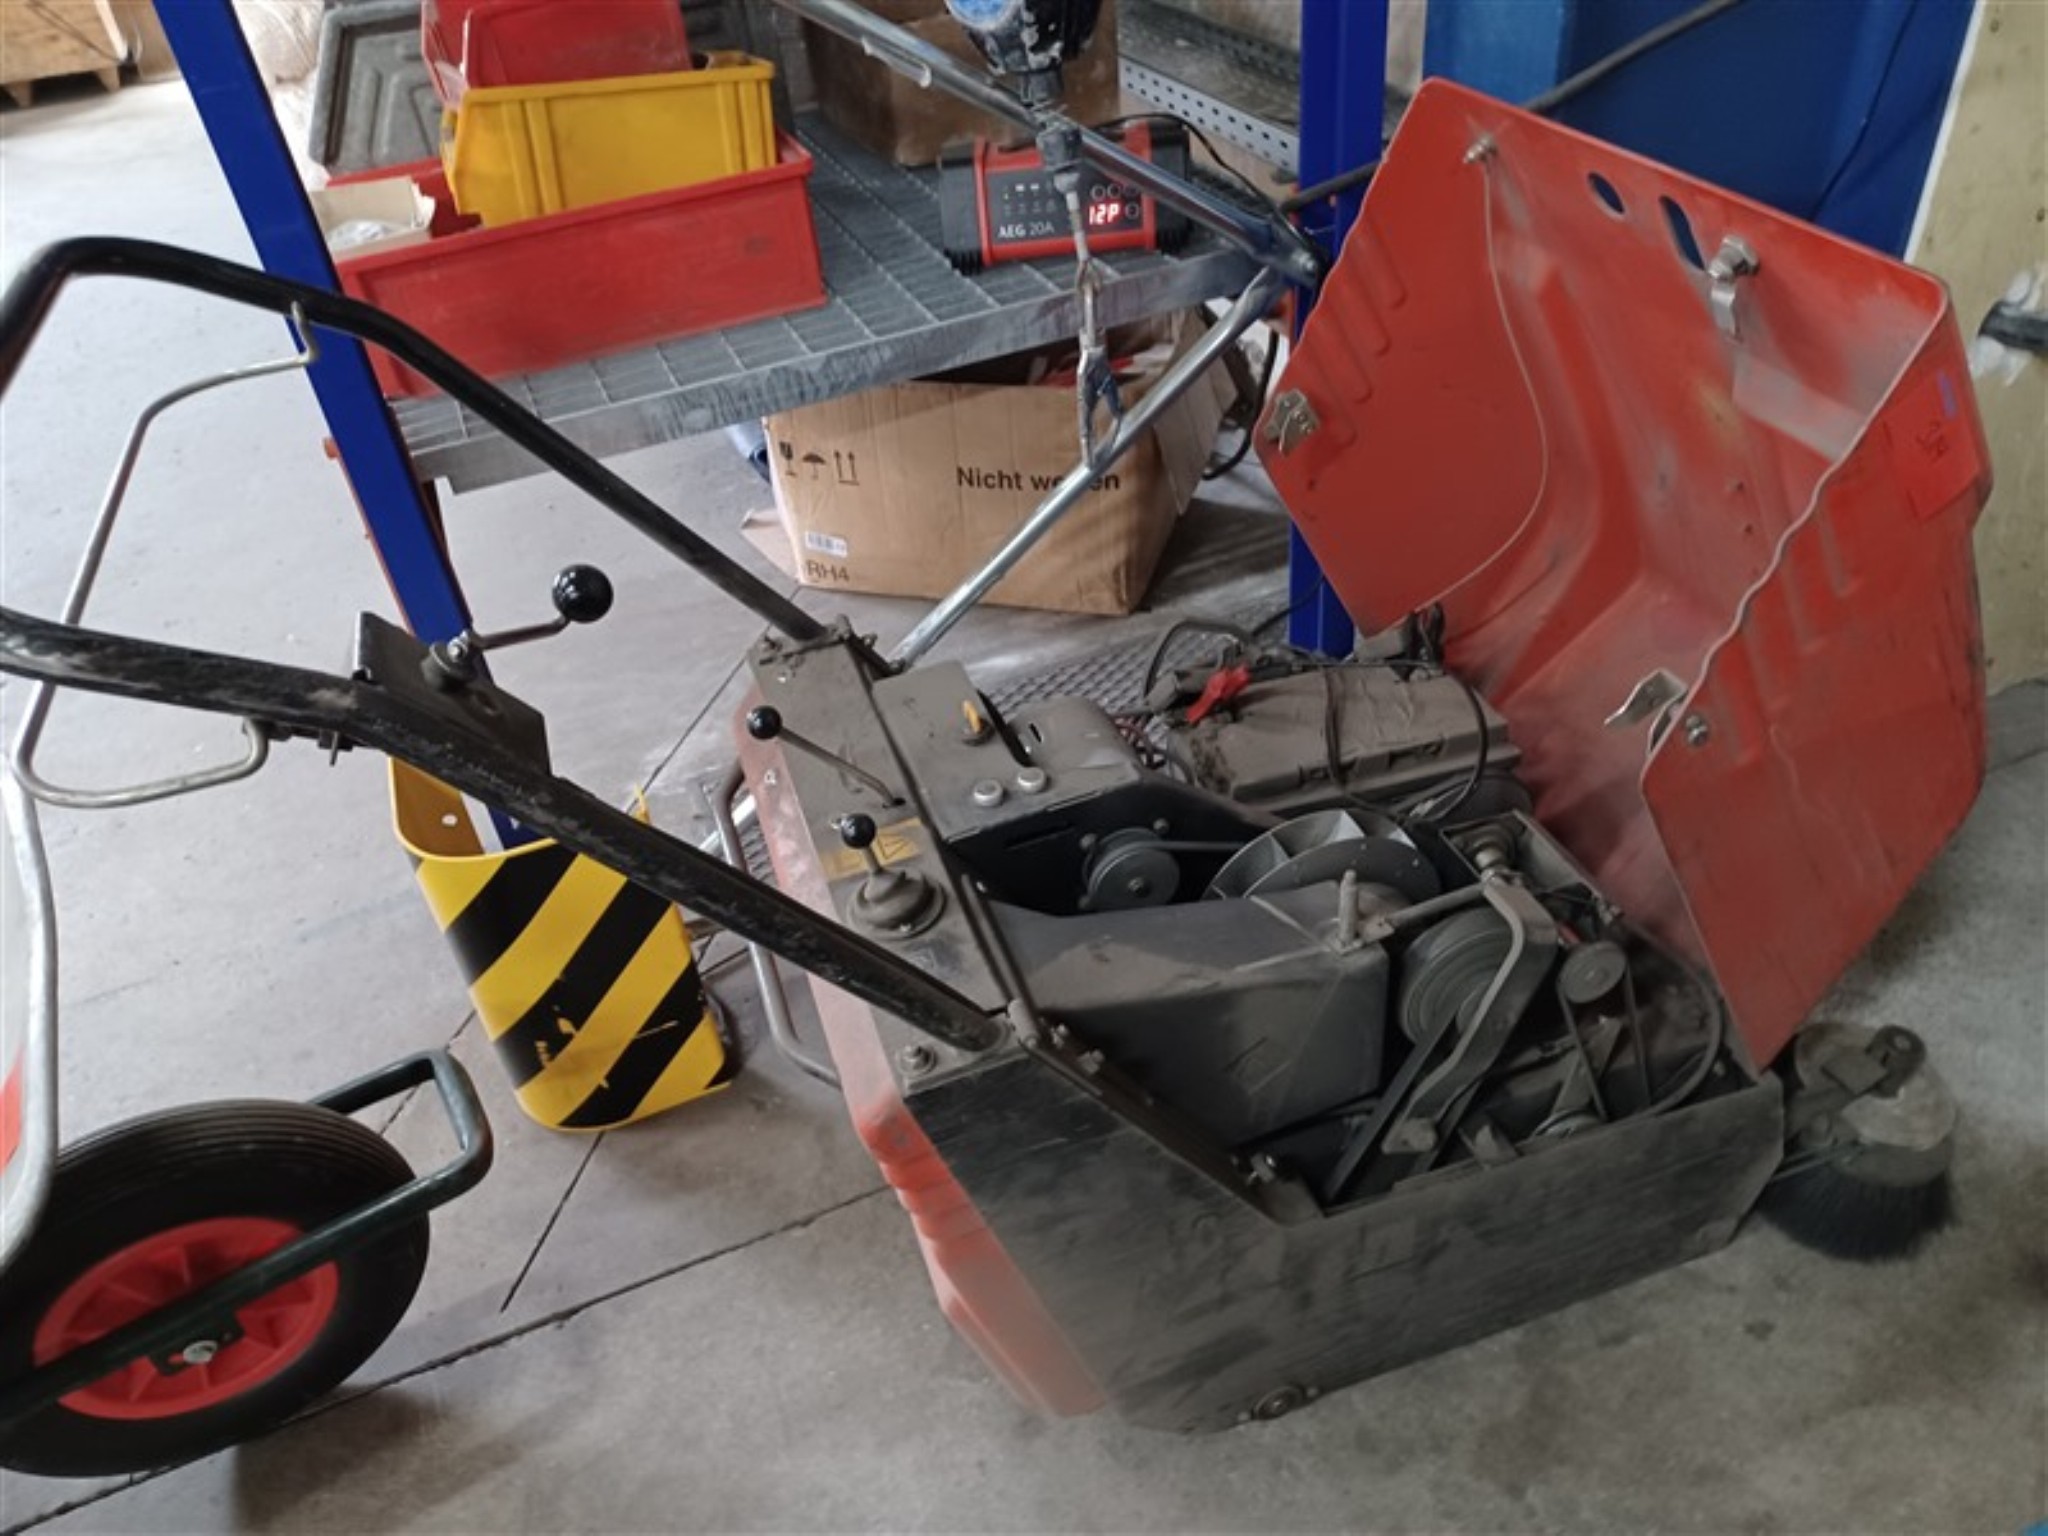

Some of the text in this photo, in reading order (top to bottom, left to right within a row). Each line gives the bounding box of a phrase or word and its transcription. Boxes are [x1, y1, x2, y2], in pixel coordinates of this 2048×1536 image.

[998, 220, 1056, 239] AEG 20A
[956, 465, 1024, 491] Nicht
